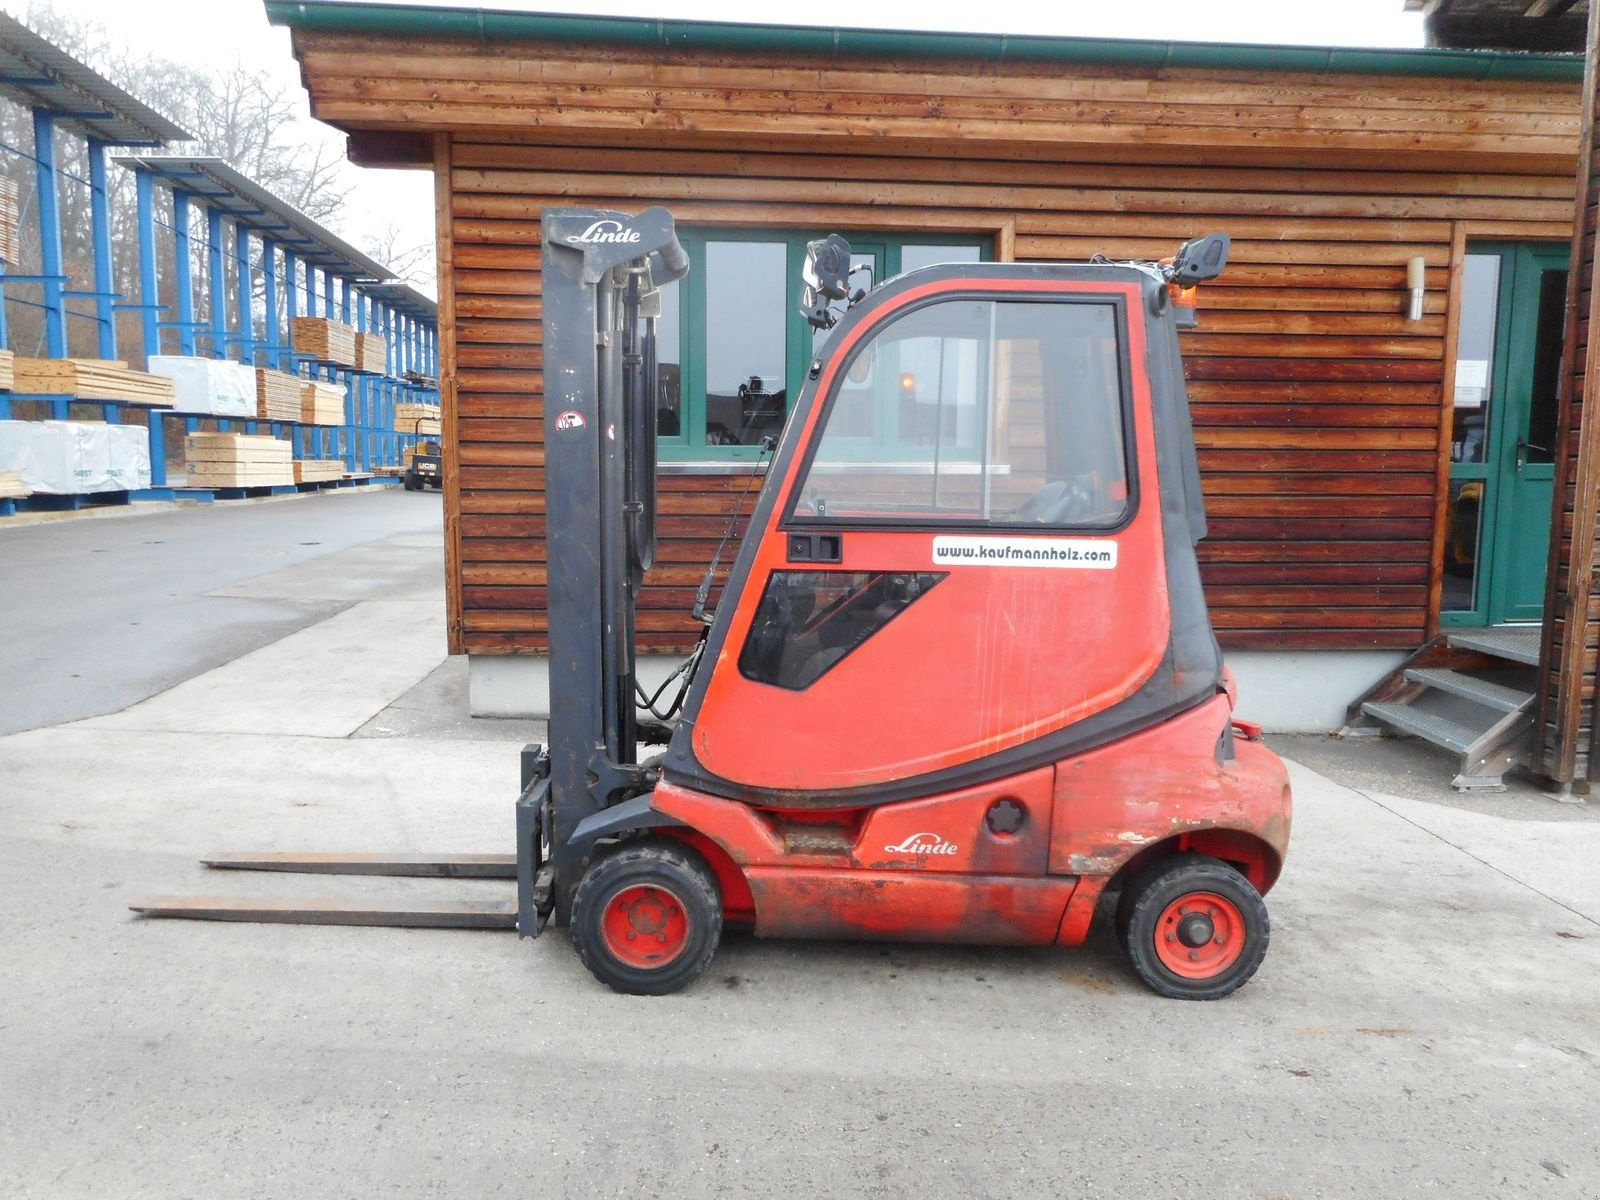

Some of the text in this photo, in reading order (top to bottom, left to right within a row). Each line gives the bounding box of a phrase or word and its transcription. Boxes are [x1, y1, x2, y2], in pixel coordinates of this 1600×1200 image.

[566, 220, 641, 243] Linde
[936, 545, 1111, 561] www.kaufmannholz.com
[884, 832, 958, 855] Linde
